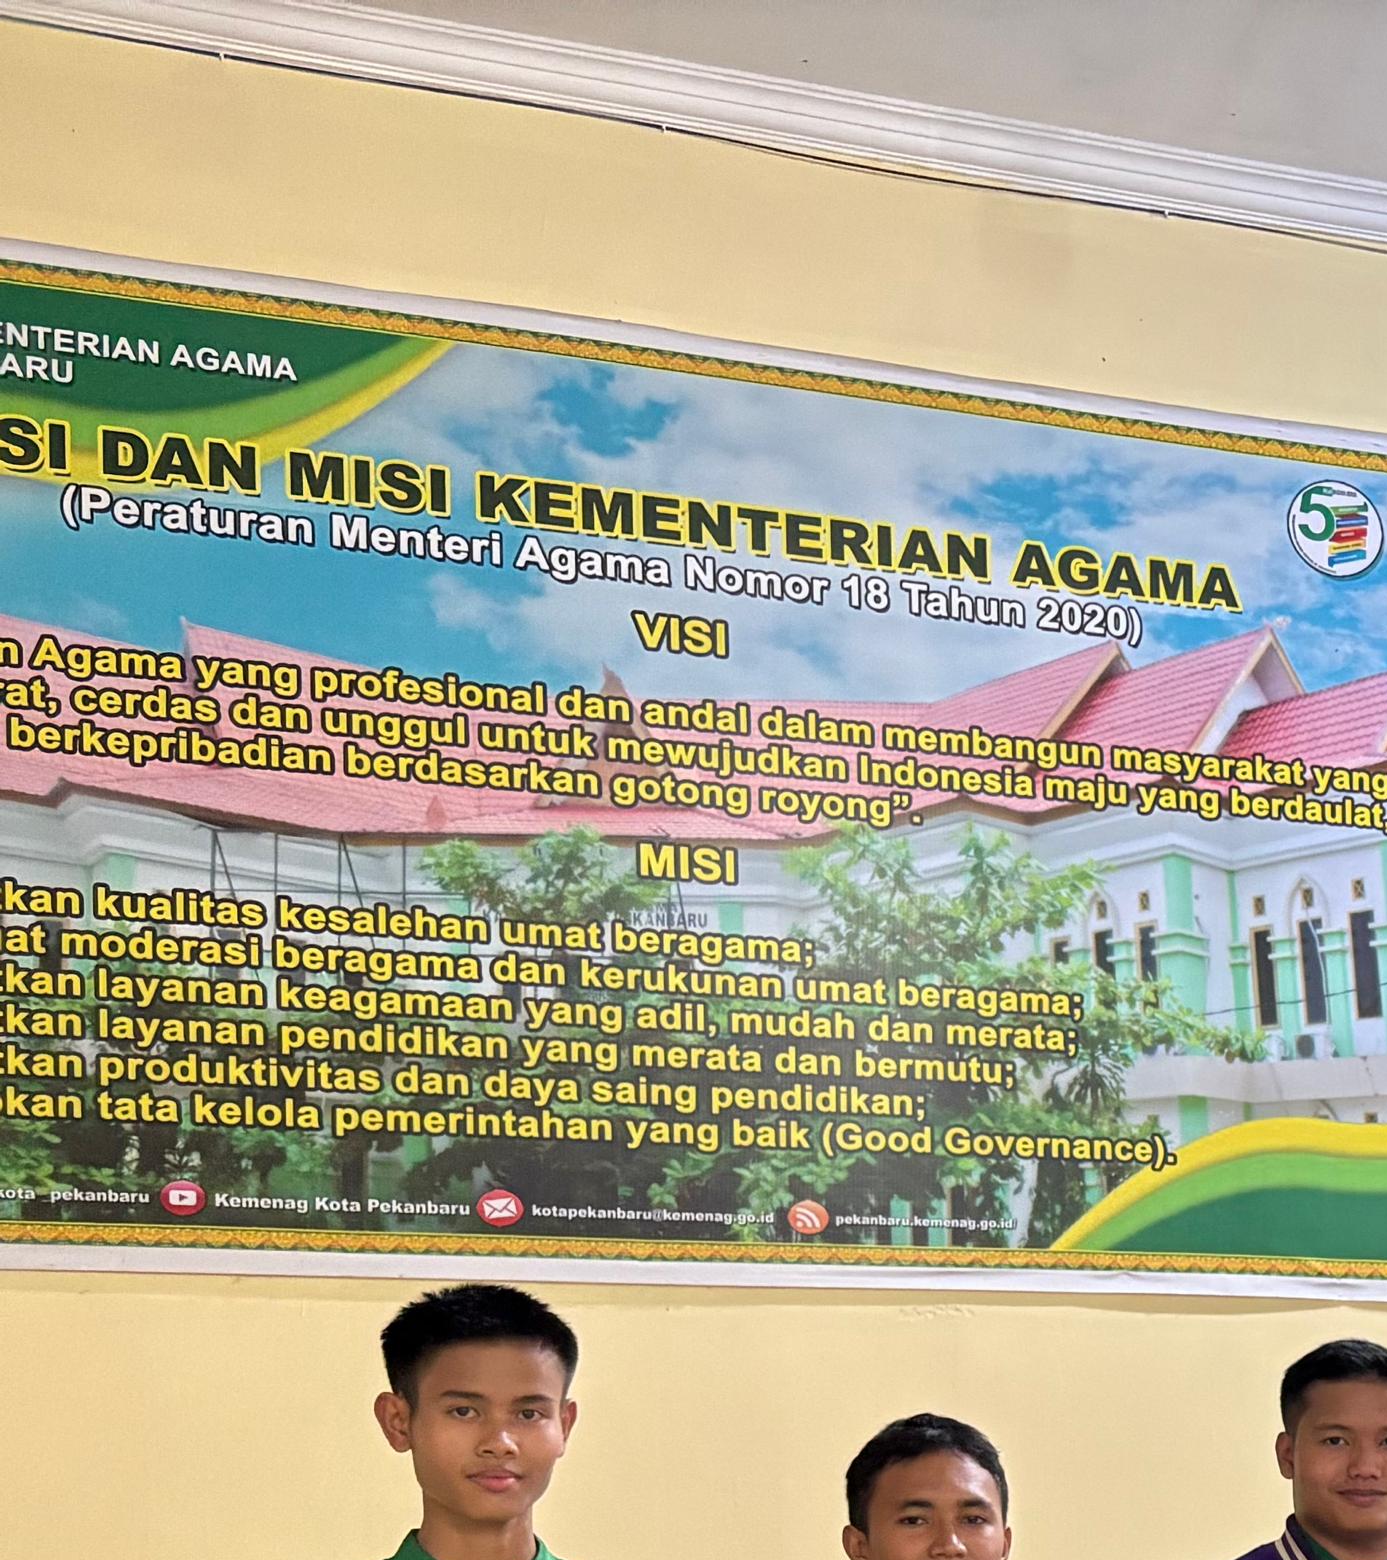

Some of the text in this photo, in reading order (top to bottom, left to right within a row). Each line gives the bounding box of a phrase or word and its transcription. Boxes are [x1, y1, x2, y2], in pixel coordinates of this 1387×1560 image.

[169, 344, 298, 382] AGAMA
[101, 427, 258, 493] DAN
[289, 450, 449, 516] MISI
[476, 474, 989, 580] KEMENTERIAN
[1012, 546, 1241, 610] AGAMA
[61, 484, 1143, 648] (Peraturan Menteri Agama Nomor 18 Tahun 2020)
[636, 615, 727, 657] VISI
[0, 680, 58, 713] at,
[73, 689, 218, 723] cerdas
[231, 697, 309, 730] dan
[324, 711, 466, 749] unggul
[480, 726, 593, 755] untuk
[607, 737, 847, 779] mewujudkan
[860, 756, 1034, 798] Indonesia
[1046, 777, 1128, 810] maju
[1140, 787, 1220, 820] yang
[32, 638, 183, 680] Agama
[196, 660, 299, 698] yang
[313, 670, 545, 713] profesional
[558, 690, 631, 721] dan
[645, 703, 749, 734] andal
[762, 712, 873, 744] dalam
[886, 726, 1102, 770] membangun
[1113, 748, 1304, 786] masyarakat
[9, 717, 332, 772] berkepribadian
[346, 746, 599, 794] berdasarkan
[613, 777, 749, 816] gotong
[640, 844, 736, 882] MISI
[0, 882, 81, 916] kan
[96, 888, 265, 927] kualitas
[279, 900, 488, 942] kesalehan
[502, 922, 601, 949] umat
[615, 925, 815, 969] beragama;
[0, 926, 1082, 1019] at moderasi beragama dan kerukunan umat beragama;
[0, 964, 1078, 1056] kan layanan keagamaan yang adil, mudah dan merata;
[0, 1004, 1016, 1089] kan layanan pendidikan yang merata dan bermutu;
[0, 1045, 925, 1118] kan produktivitas dan daya saing pendidikan;
[0, 1086, 1178, 1171] kan tata kelola pemerintahan yang baik (Good Governance).
[213, 1192, 471, 1216] Kemenag Kota Pekanbaru
[531, 1203, 775, 1226] kotapekanbaru@kemenag.go.id
